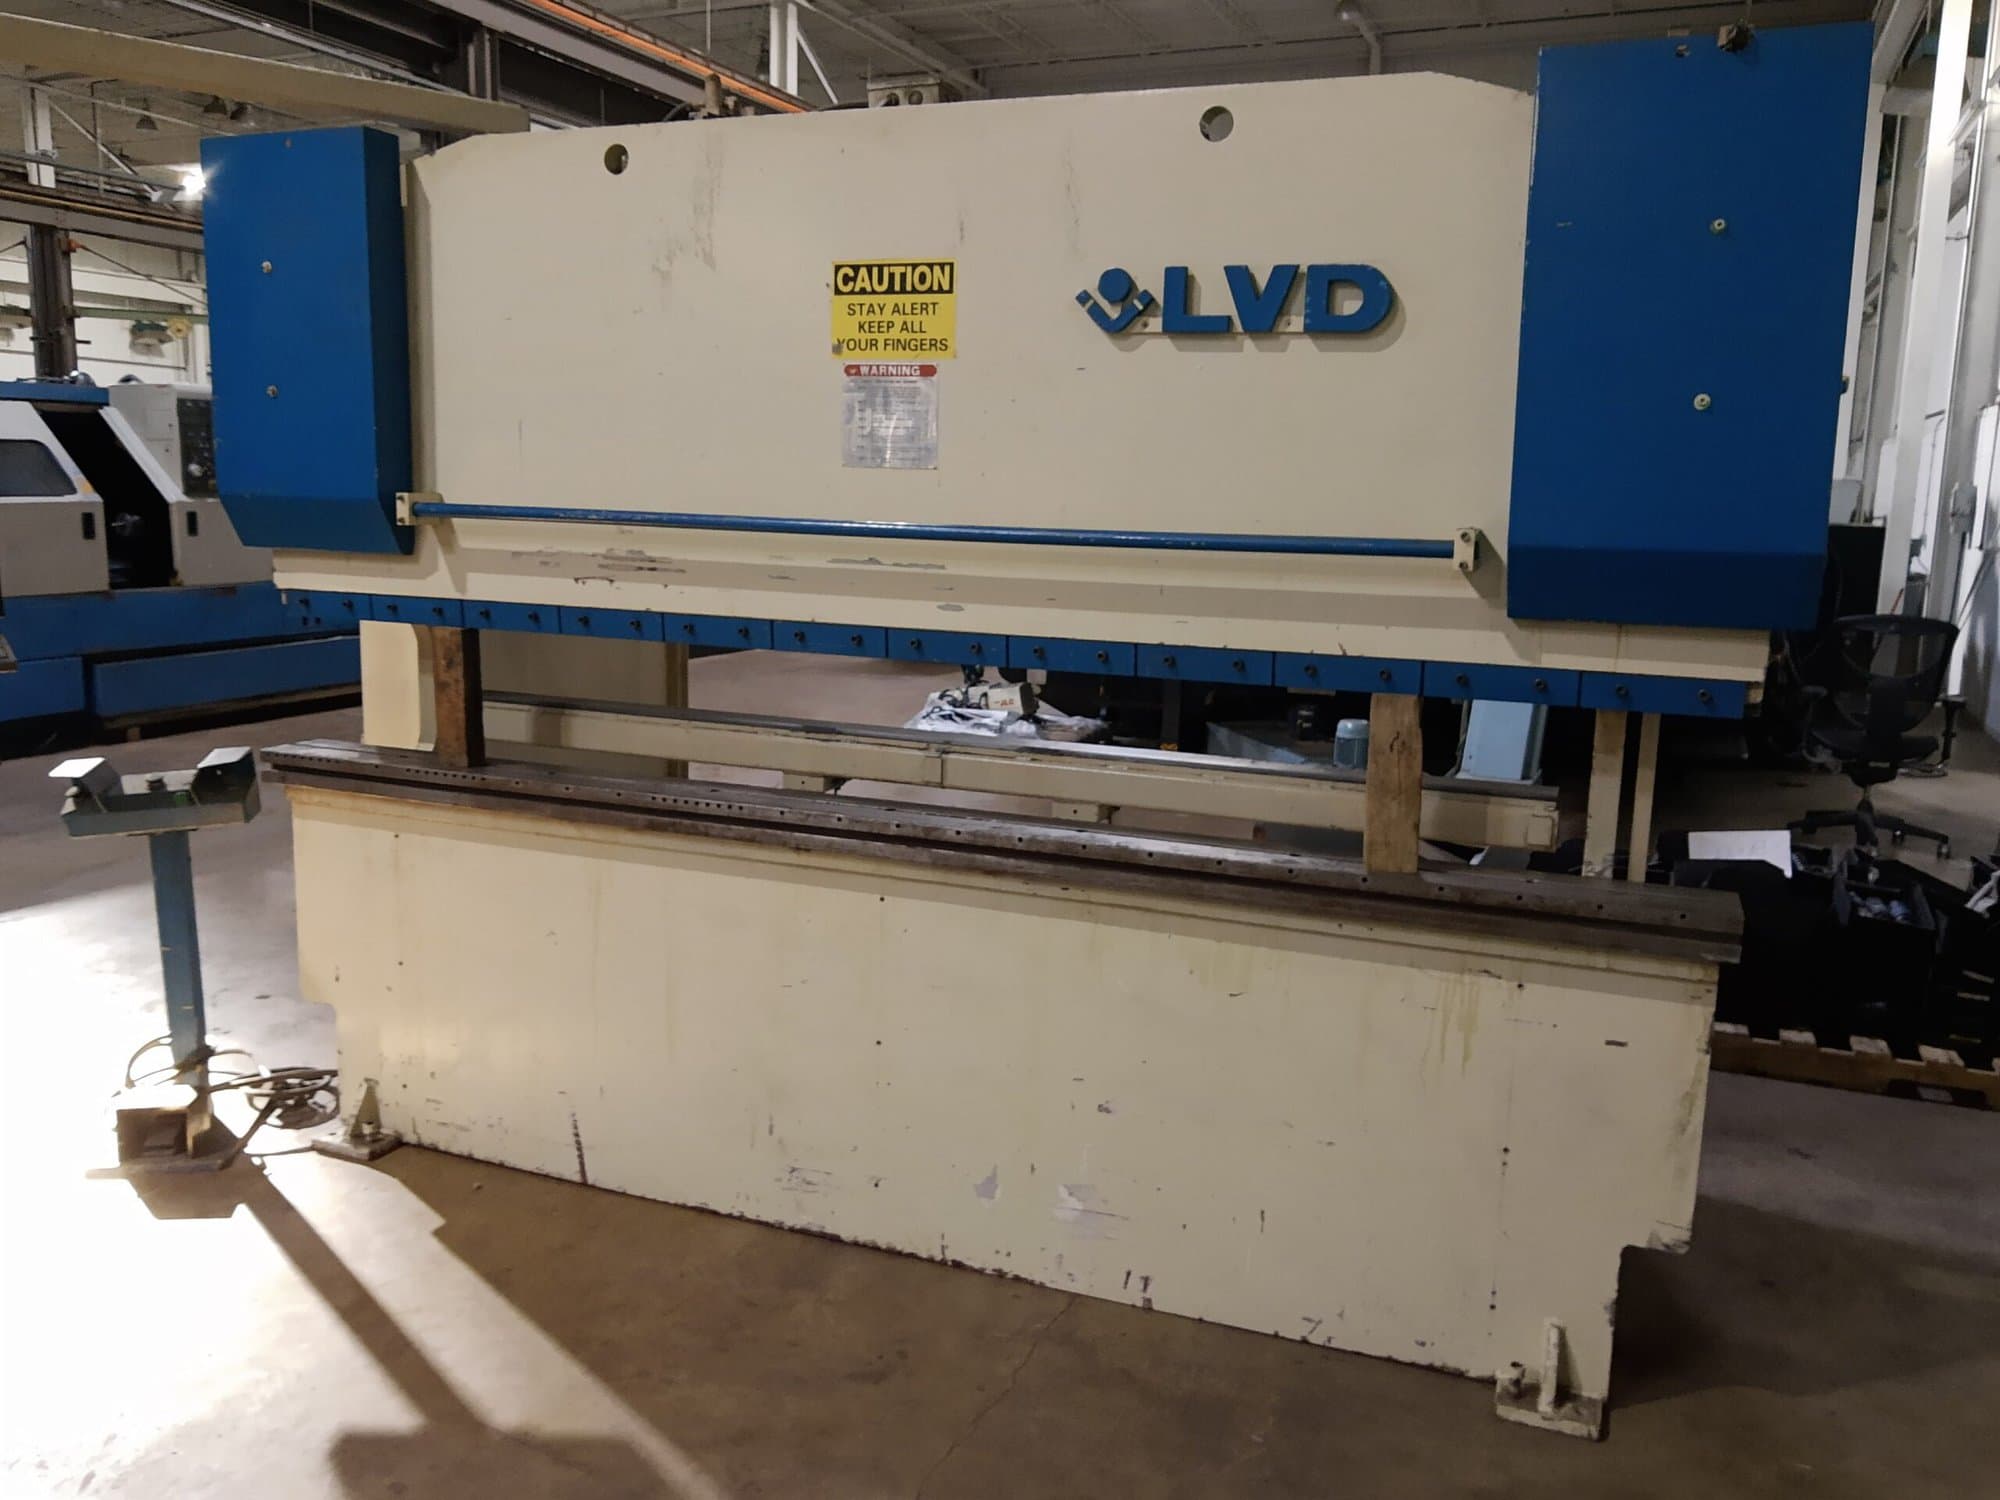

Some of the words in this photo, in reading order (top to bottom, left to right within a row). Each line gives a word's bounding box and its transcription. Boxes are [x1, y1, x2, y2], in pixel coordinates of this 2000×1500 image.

[836, 264, 951, 293] CAUTION
[1162, 264, 1392, 333] LVD
[847, 302, 886, 316] STAY
[891, 302, 939, 316] ALERT
[858, 320, 895, 334] KEEP
[899, 320, 927, 334] ALL
[883, 338, 949, 352] FINGERS
[860, 365, 921, 377] WARNING
